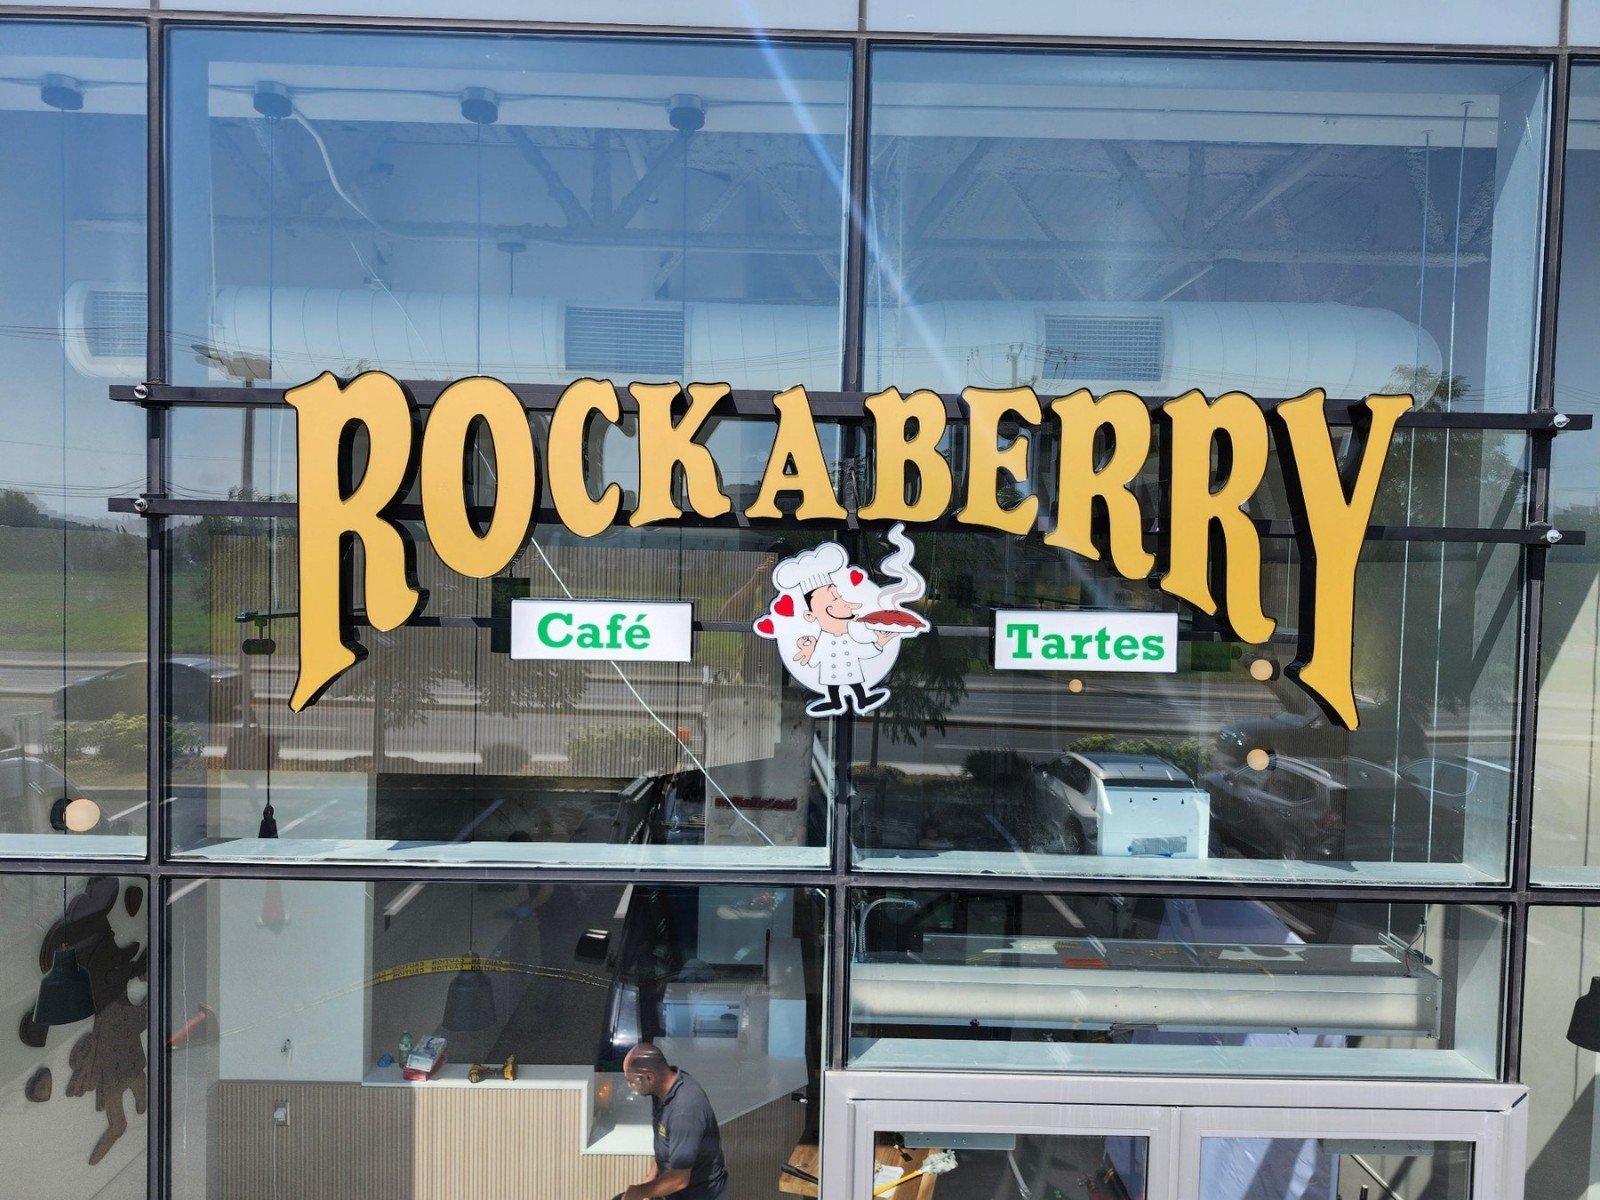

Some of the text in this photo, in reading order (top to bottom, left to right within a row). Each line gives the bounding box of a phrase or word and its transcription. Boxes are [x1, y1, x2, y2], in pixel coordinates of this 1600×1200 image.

[285, 371, 1414, 731] ROCKABERRY
[537, 612, 651, 650] Café
[1006, 623, 1165, 661] Tartes
